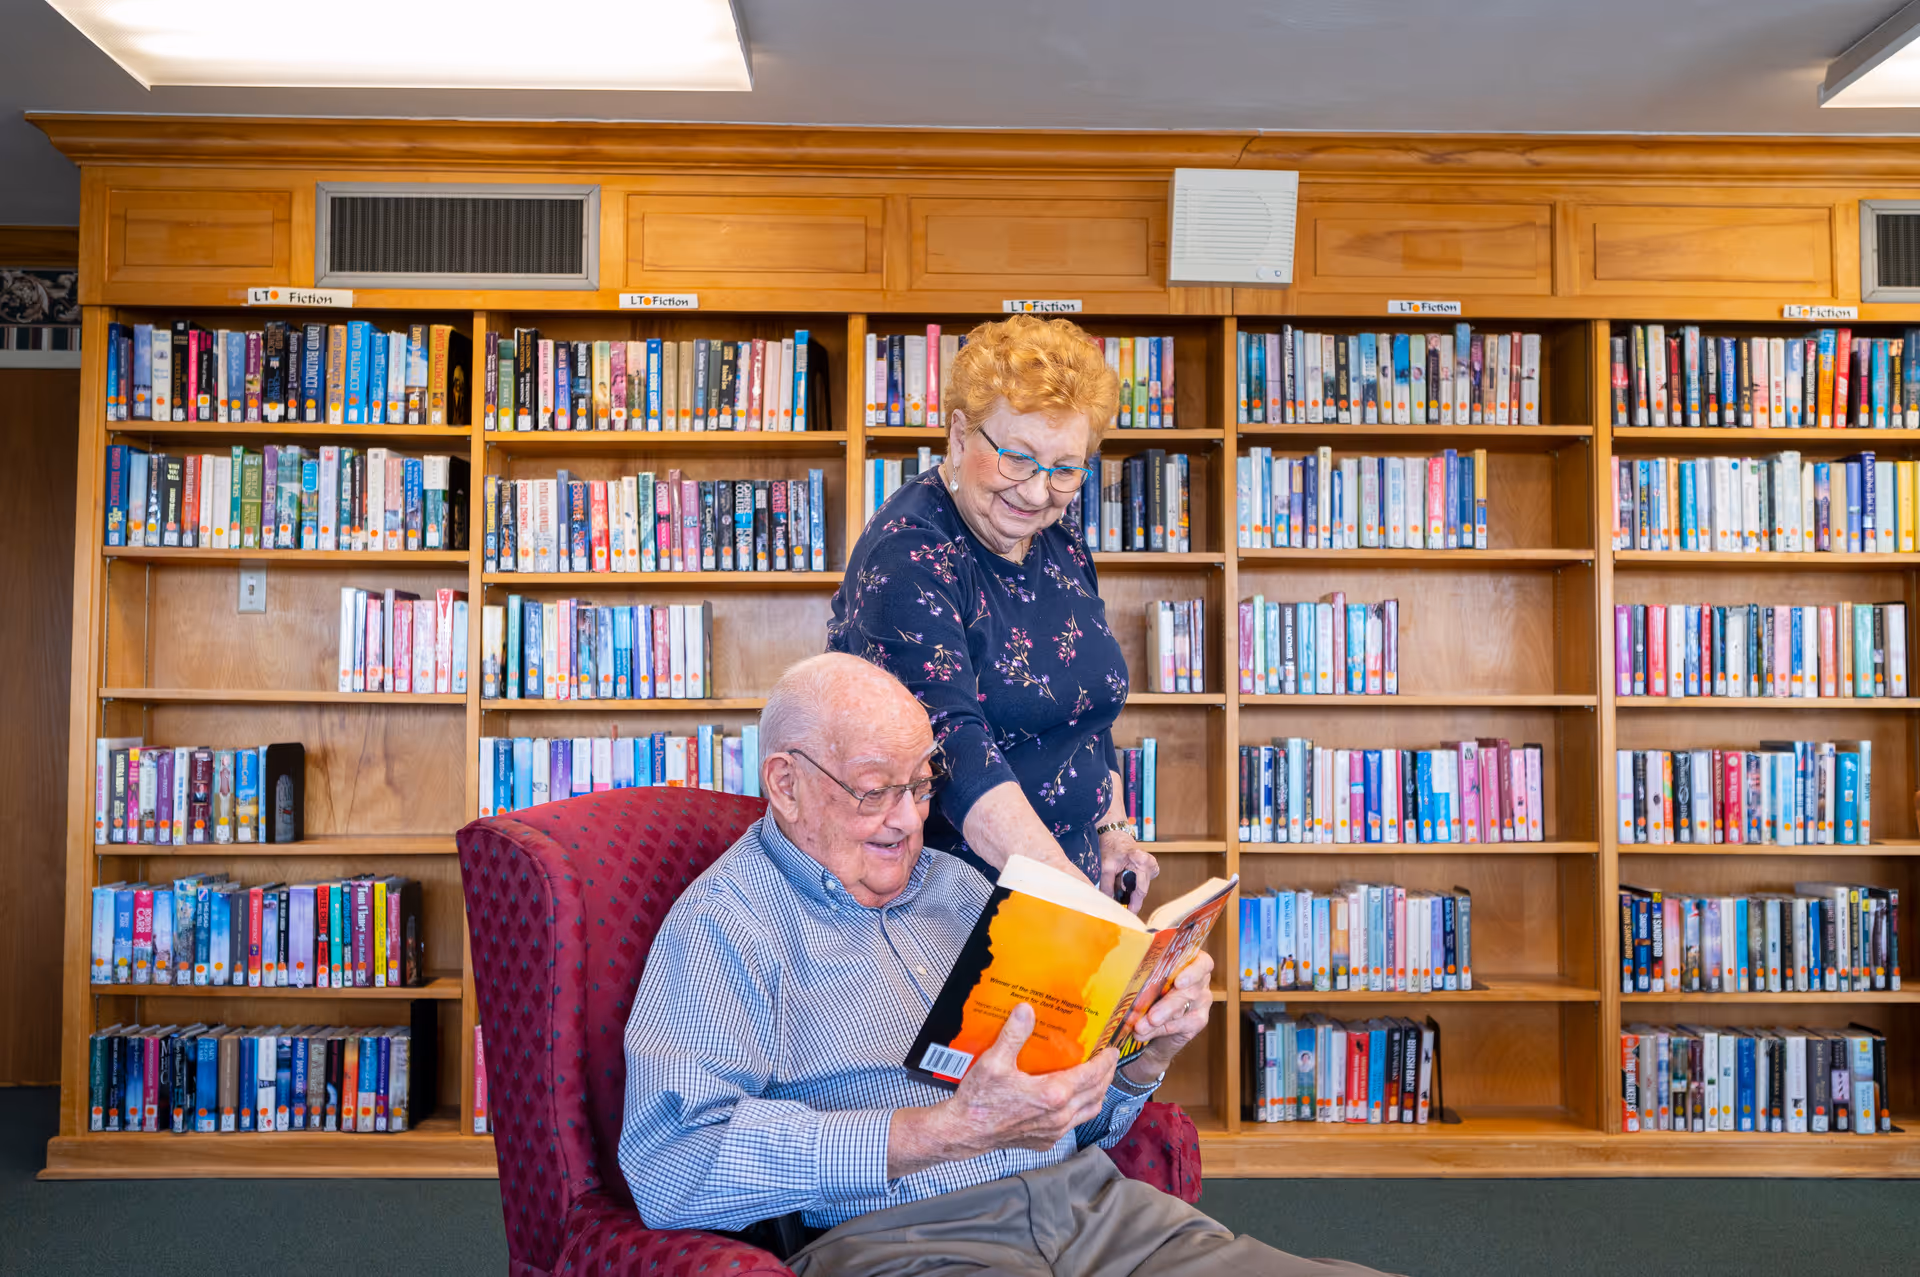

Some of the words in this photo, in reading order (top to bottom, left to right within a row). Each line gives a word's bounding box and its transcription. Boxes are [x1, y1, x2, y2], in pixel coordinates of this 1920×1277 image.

[289, 292, 333, 305] Fiction
[652, 295, 689, 306] Fiction
[1032, 301, 1076, 312] Fiction
[1421, 302, 1458, 312] Fiction
[1809, 306, 1851, 318] Fiction
[307, 325, 320, 350] DAVID
[352, 323, 362, 349] DAVID
[412, 326, 421, 349] DAVID
[435, 328, 445, 352] DAVID
[305, 350, 319, 389] BALDACCI
[349, 351, 361, 391] BALDACCI
[434, 353, 444, 390] BALDACCI
[735, 484, 743, 515] COULTER
[743, 483, 752, 514] CATHERINE
[357, 886, 369, 904] Tom
[136, 908, 145, 933] CARR
[355, 906, 369, 932] Clancy
[1639, 913, 1648, 939] SANDFORD
[1624, 925, 1633, 959] SANDFORD
[1652, 919, 1663, 957] SANDFORD
[989, 977, 1010, 988] Winner
[1018, 985, 1029, 993] the
[1045, 994, 1060, 1004] Mary
[1061, 999, 1083, 1011] Higgins
[1083, 1006, 1100, 1017] Clark
[1010, 991, 1029, 1001] Award
[1039, 1000, 1054, 1009] Dark
[1055, 1005, 1074, 1015] Angel
[297, 1041, 305, 1060] MARY
[1406, 1039, 1416, 1069] BRUSH
[296, 1060, 304, 1074] JANE
[1626, 1059, 1636, 1072] THE
[295, 1074, 303, 1095] CLARK
[1405, 1070, 1416, 1092] BACK
[1625, 1072, 1636, 1103] UNLIKELY
